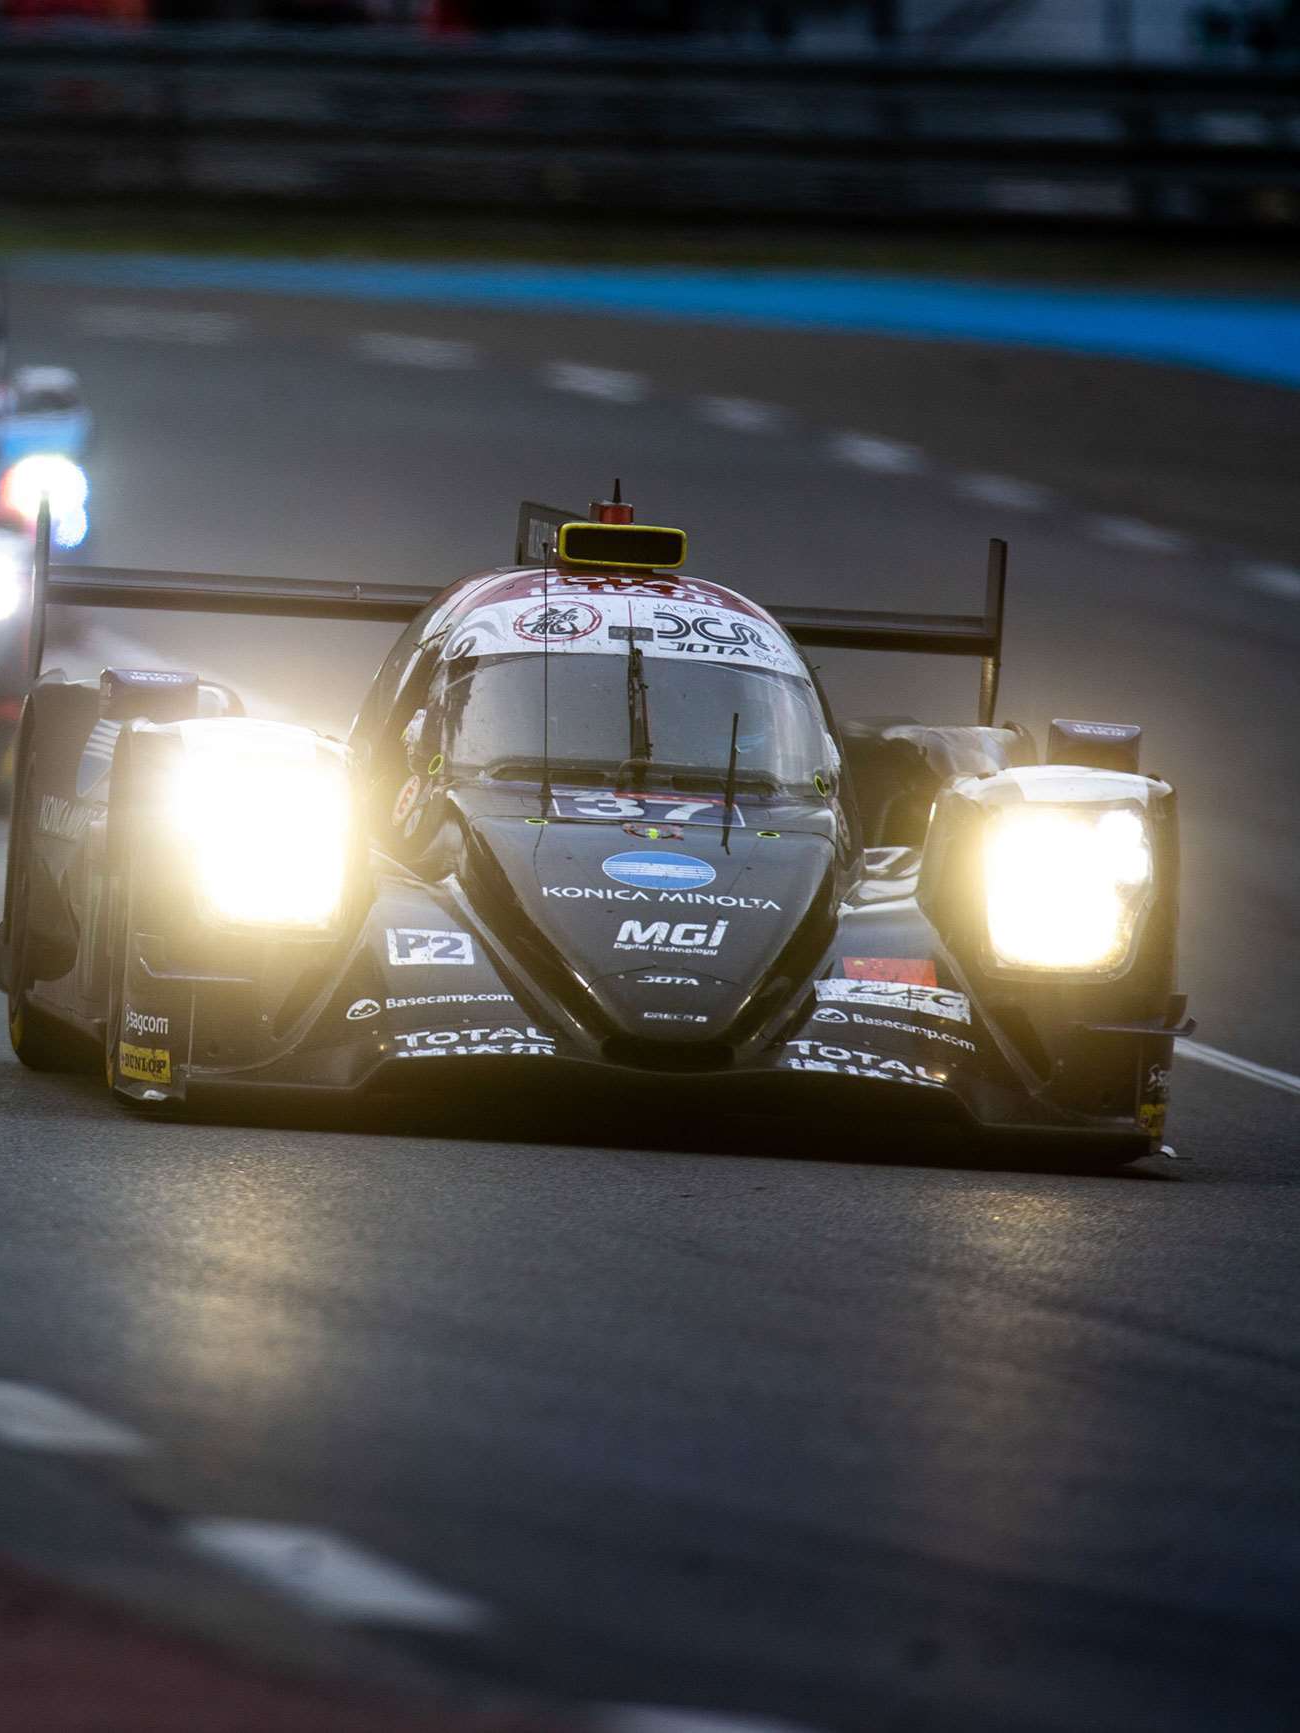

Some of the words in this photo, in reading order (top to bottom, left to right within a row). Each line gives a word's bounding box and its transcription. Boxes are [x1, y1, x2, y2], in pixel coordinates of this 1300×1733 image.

[659, 641, 750, 657] JOTA
[573, 797, 714, 821] 37
[542, 886, 650, 902] KONICA
[658, 891, 781, 910] MINOLTA
[396, 933, 466, 960] P2
[613, 942, 650, 951] Digital
[653, 944, 719, 956] Technology
[636, 975, 700, 986] JOTA
[386, 992, 515, 1010] Basecamp.com
[395, 1027, 555, 1048] TOTAL
[852, 1013, 976, 1052] Basecamp.com
[786, 1040, 948, 1083] TOTAL
